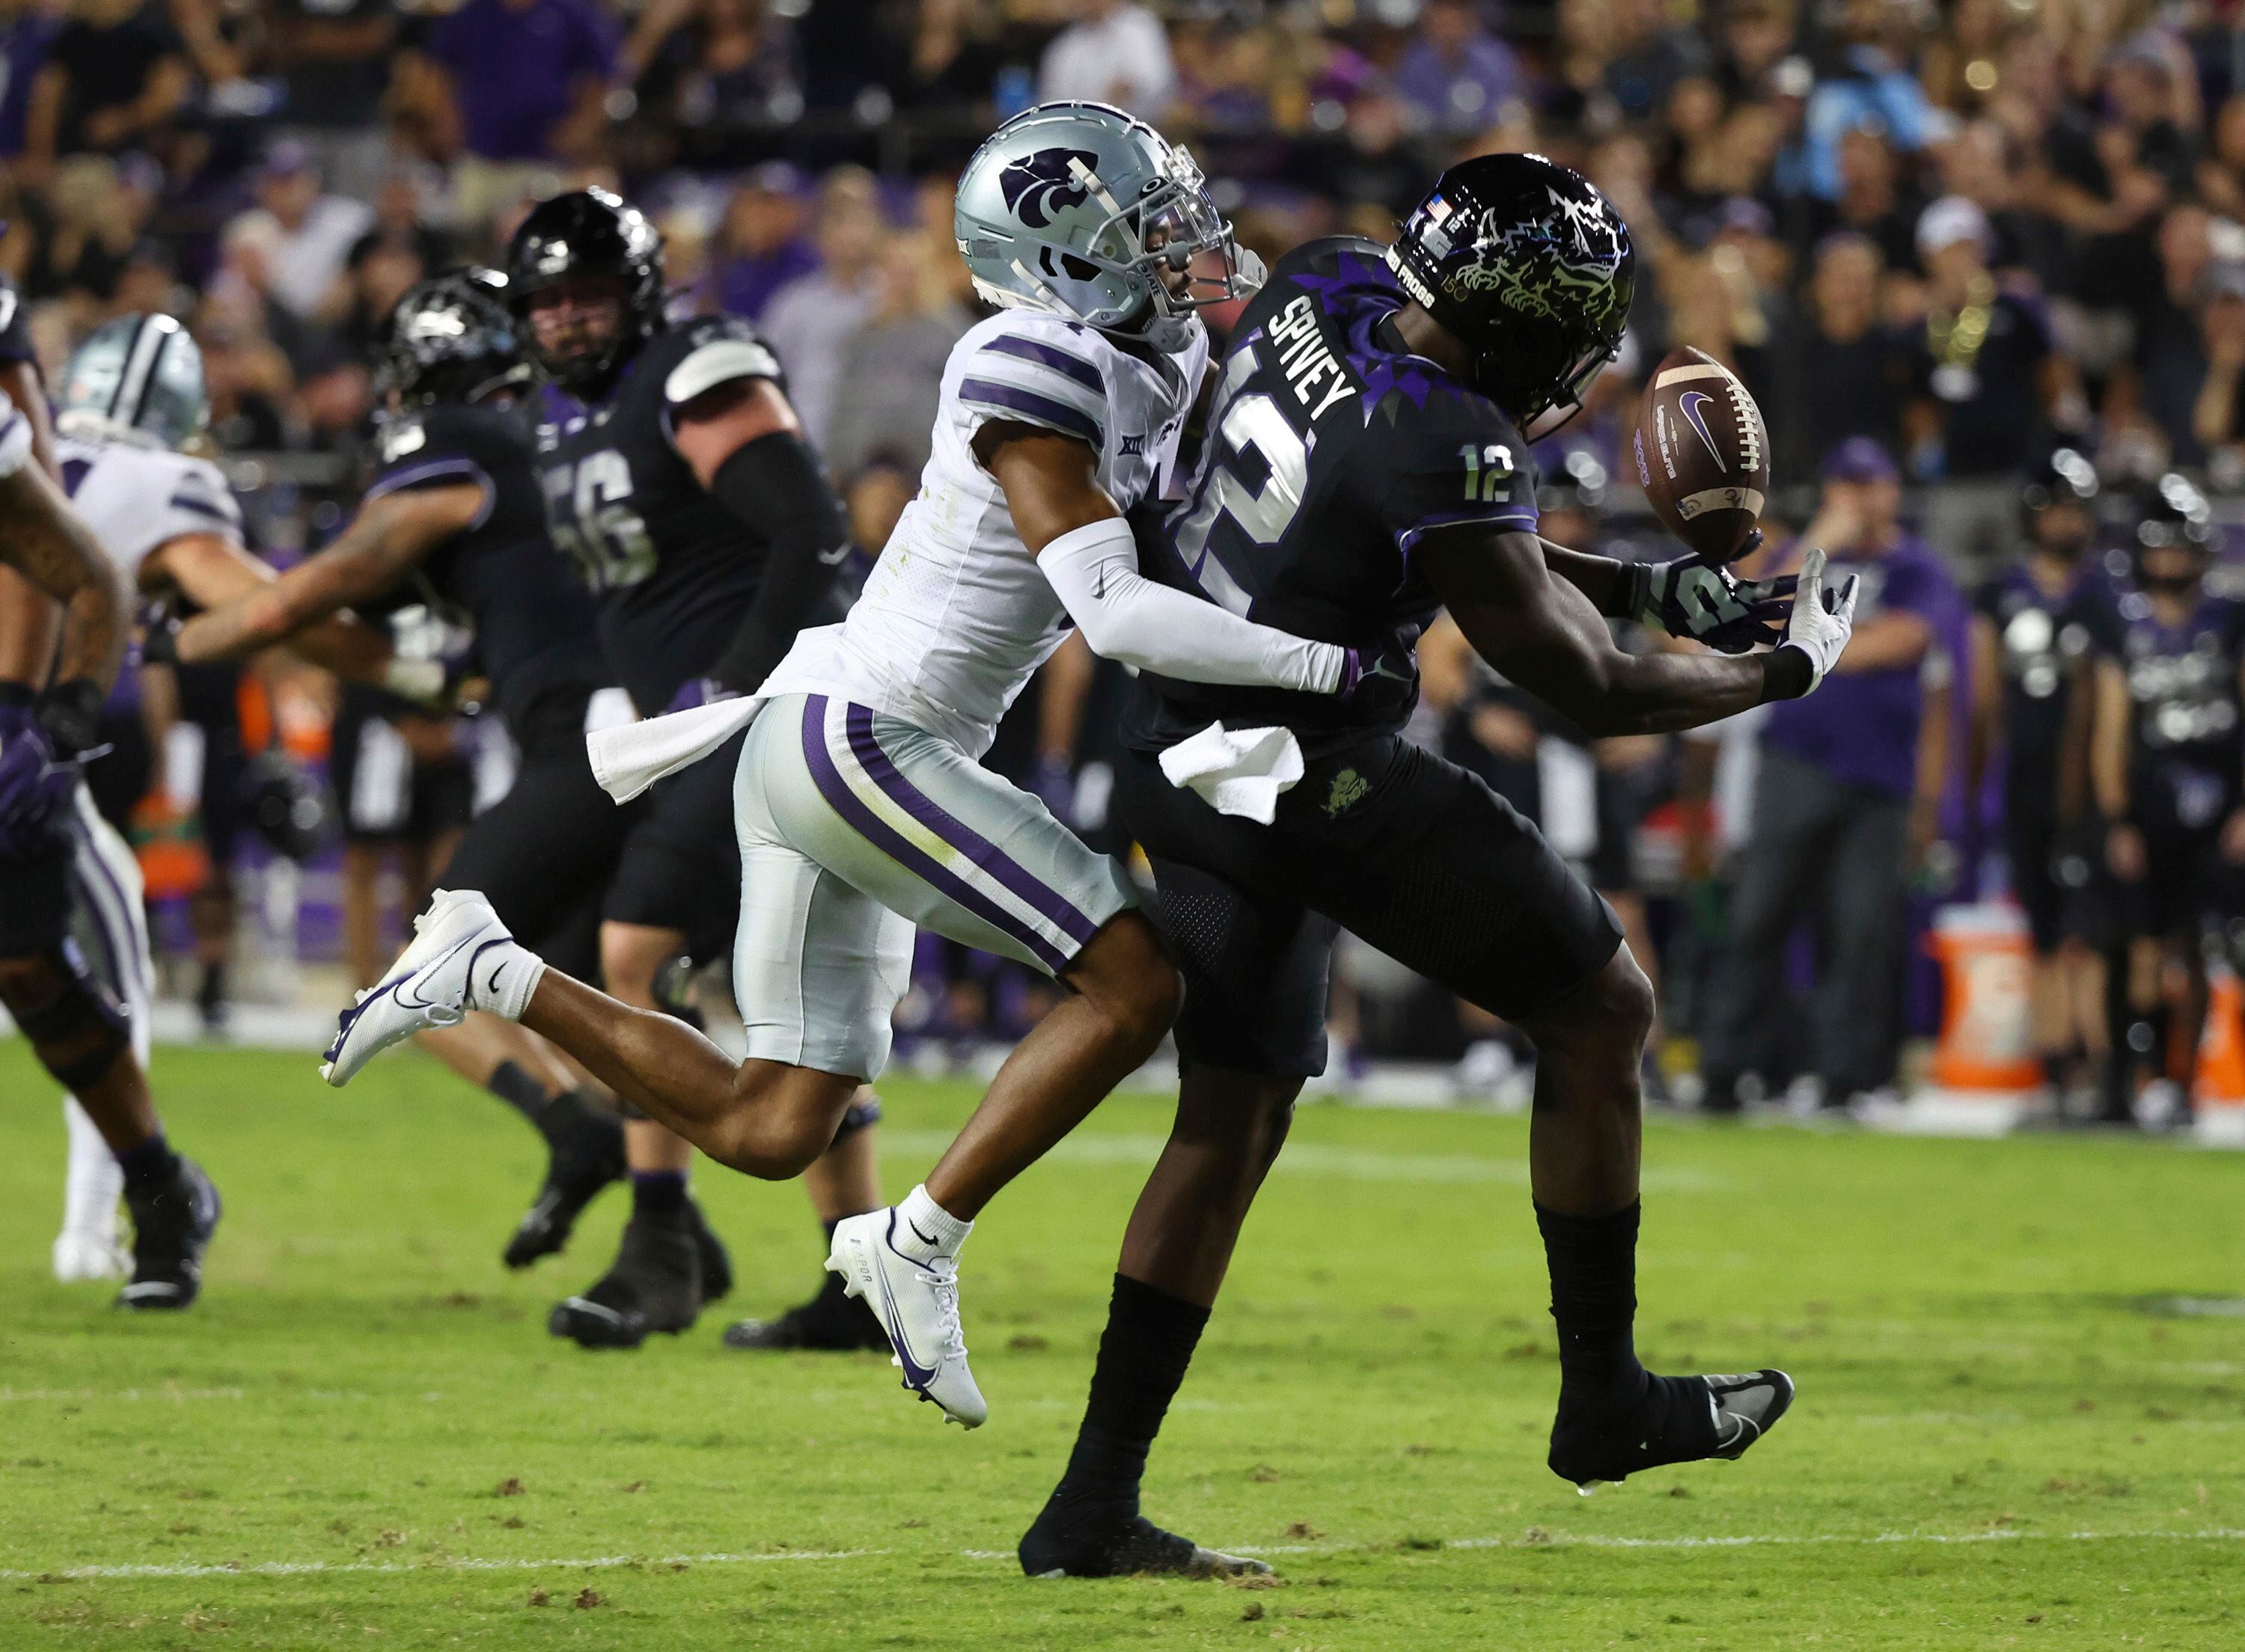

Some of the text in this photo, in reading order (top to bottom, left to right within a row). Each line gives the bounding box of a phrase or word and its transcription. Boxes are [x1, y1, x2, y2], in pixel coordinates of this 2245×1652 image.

[1397, 263, 1436, 310] FROGS
[1268, 295, 1357, 422] SPIVEY
[1460, 444, 1515, 503] 12
[1660, 442, 1677, 480] ELITE
[850, 1238, 873, 1282] POR
